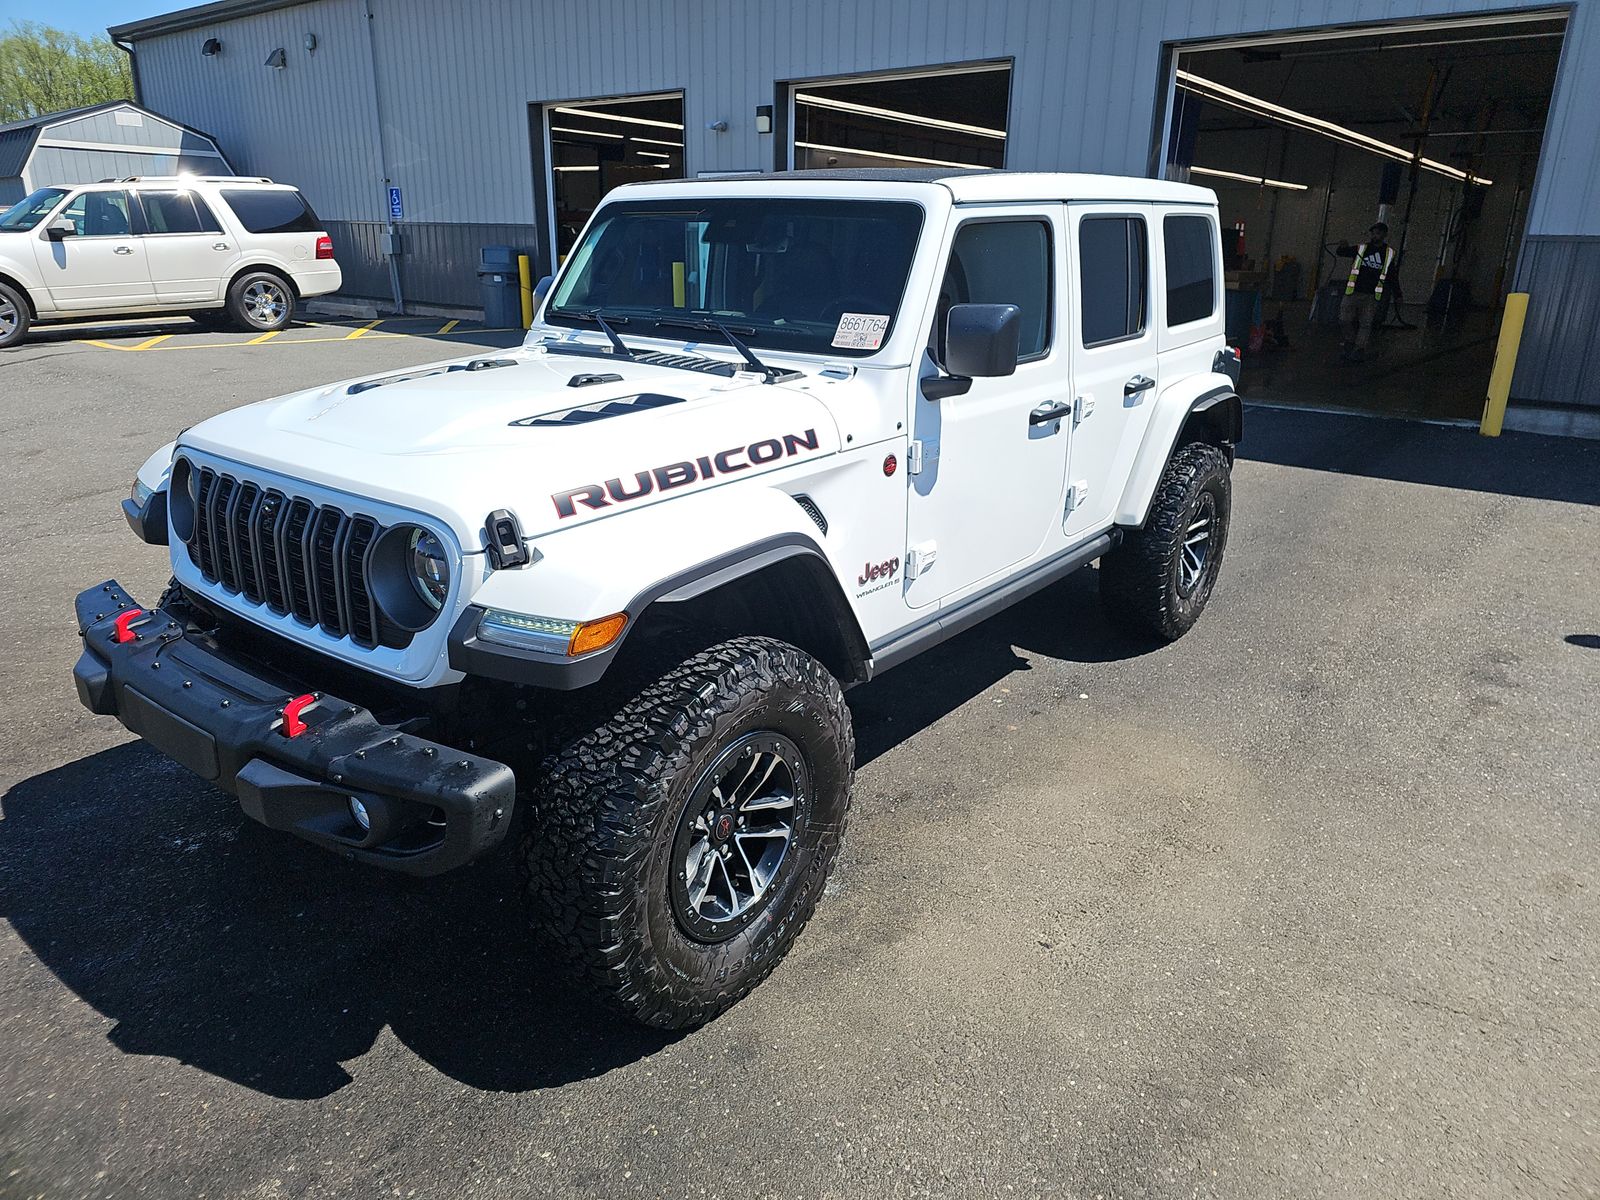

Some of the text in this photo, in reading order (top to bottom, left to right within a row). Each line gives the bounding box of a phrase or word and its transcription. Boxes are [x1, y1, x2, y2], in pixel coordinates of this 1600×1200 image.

[840, 317, 887, 332] 8661764
[551, 428, 820, 519] RUBICON
[858, 557, 900, 587] Jeep
[856, 580, 893, 599] WRANGLER
